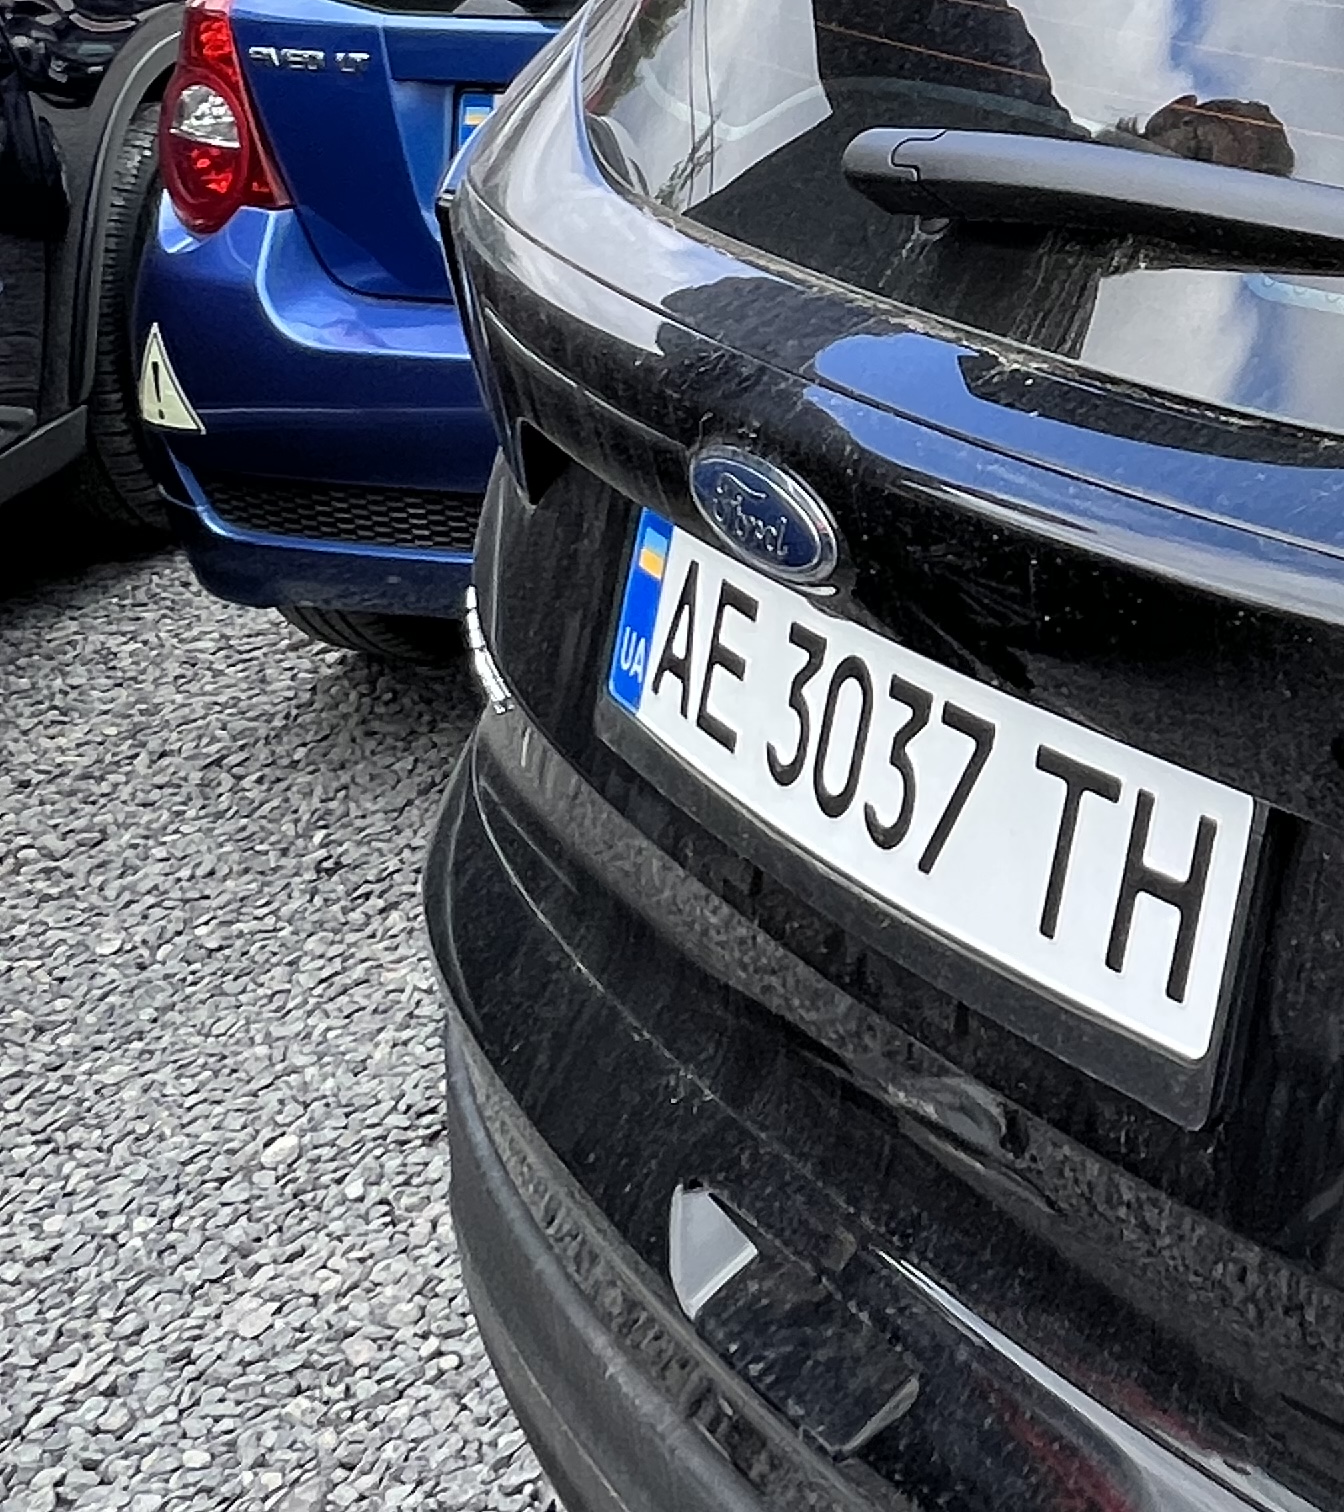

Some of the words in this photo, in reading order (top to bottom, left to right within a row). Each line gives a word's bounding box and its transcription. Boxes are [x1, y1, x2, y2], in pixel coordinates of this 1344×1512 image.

[620, 625, 646, 683] UA
[652, 558, 760, 756] AE
[766, 621, 996, 876] 3037
[1035, 744, 1219, 1004] TH
